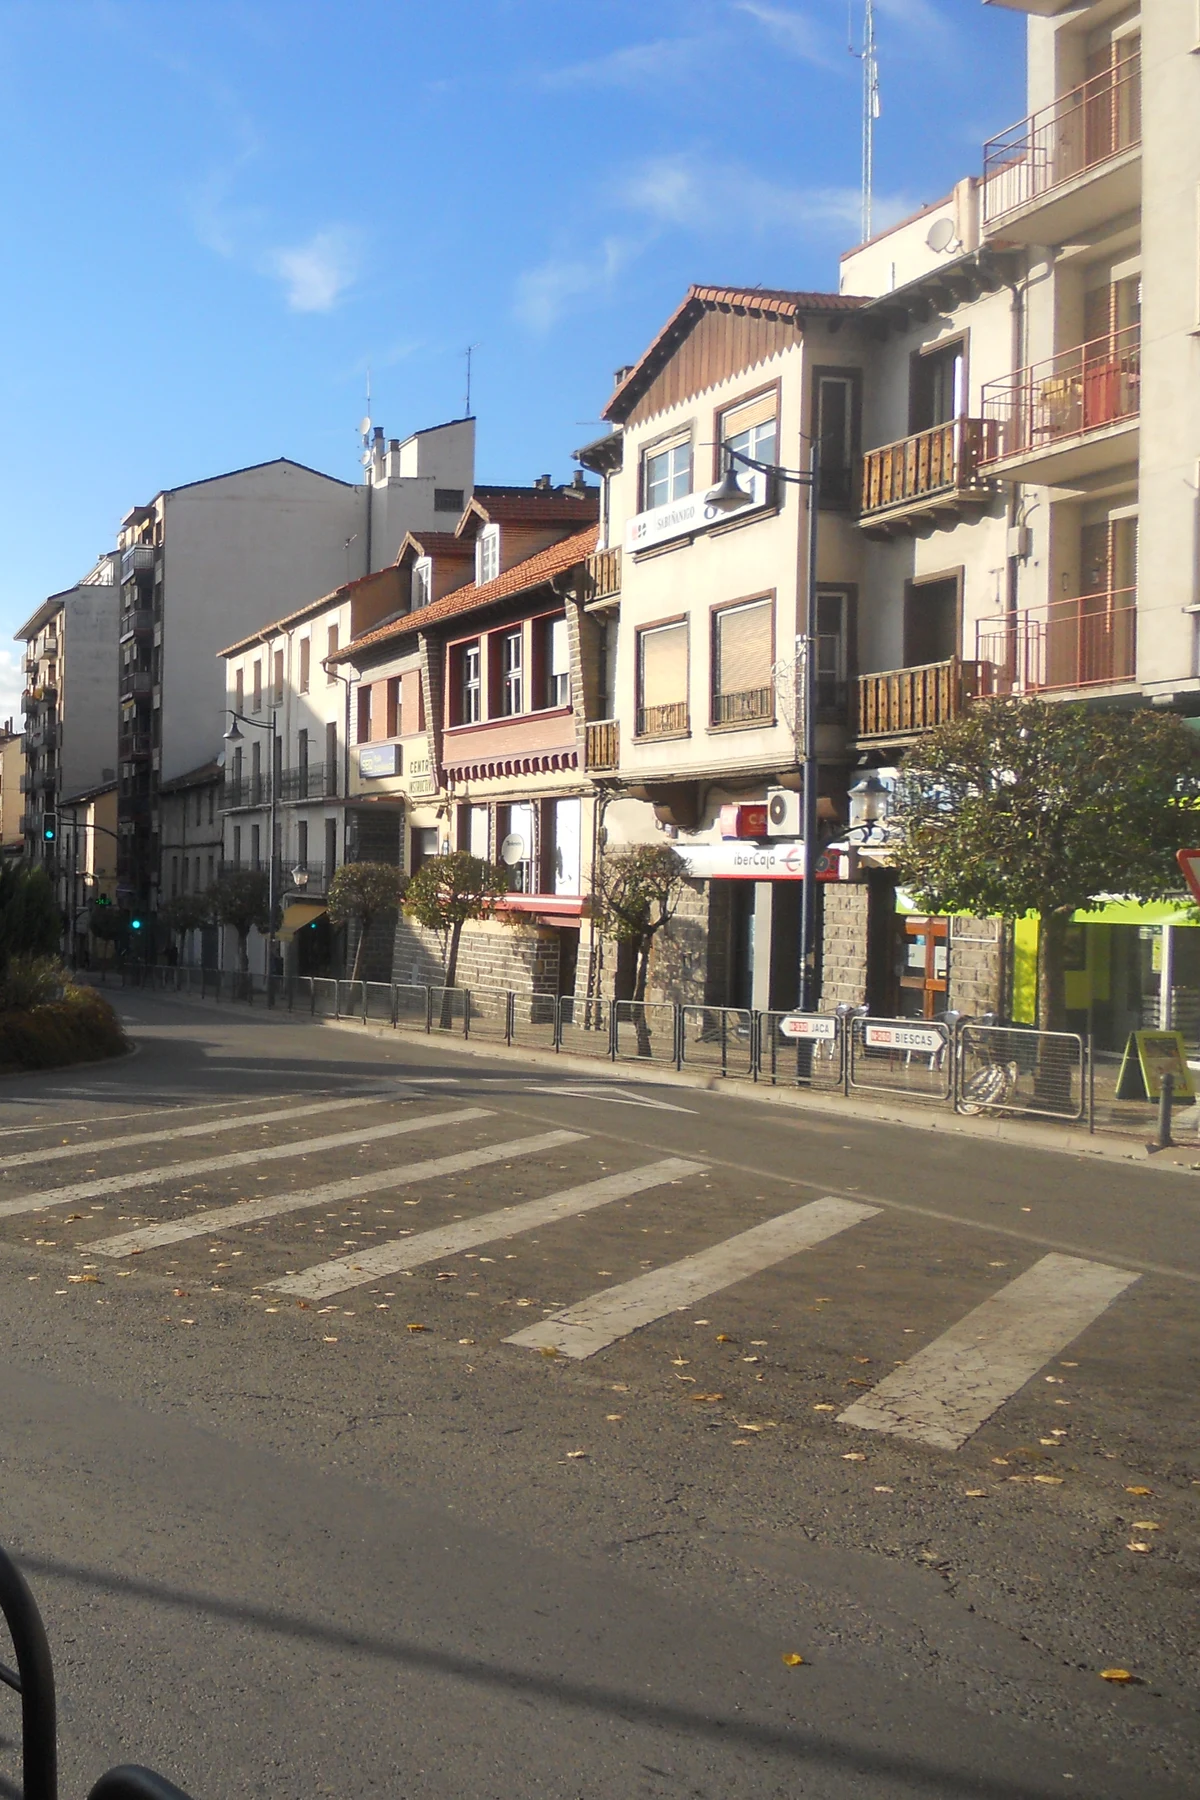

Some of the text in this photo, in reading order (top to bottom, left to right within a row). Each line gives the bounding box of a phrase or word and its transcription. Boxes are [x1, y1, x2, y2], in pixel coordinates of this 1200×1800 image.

[409, 760, 429, 774] CENTR
[811, 1023, 830, 1033] JACA
[895, 1032, 933, 1046] BIESCAS
